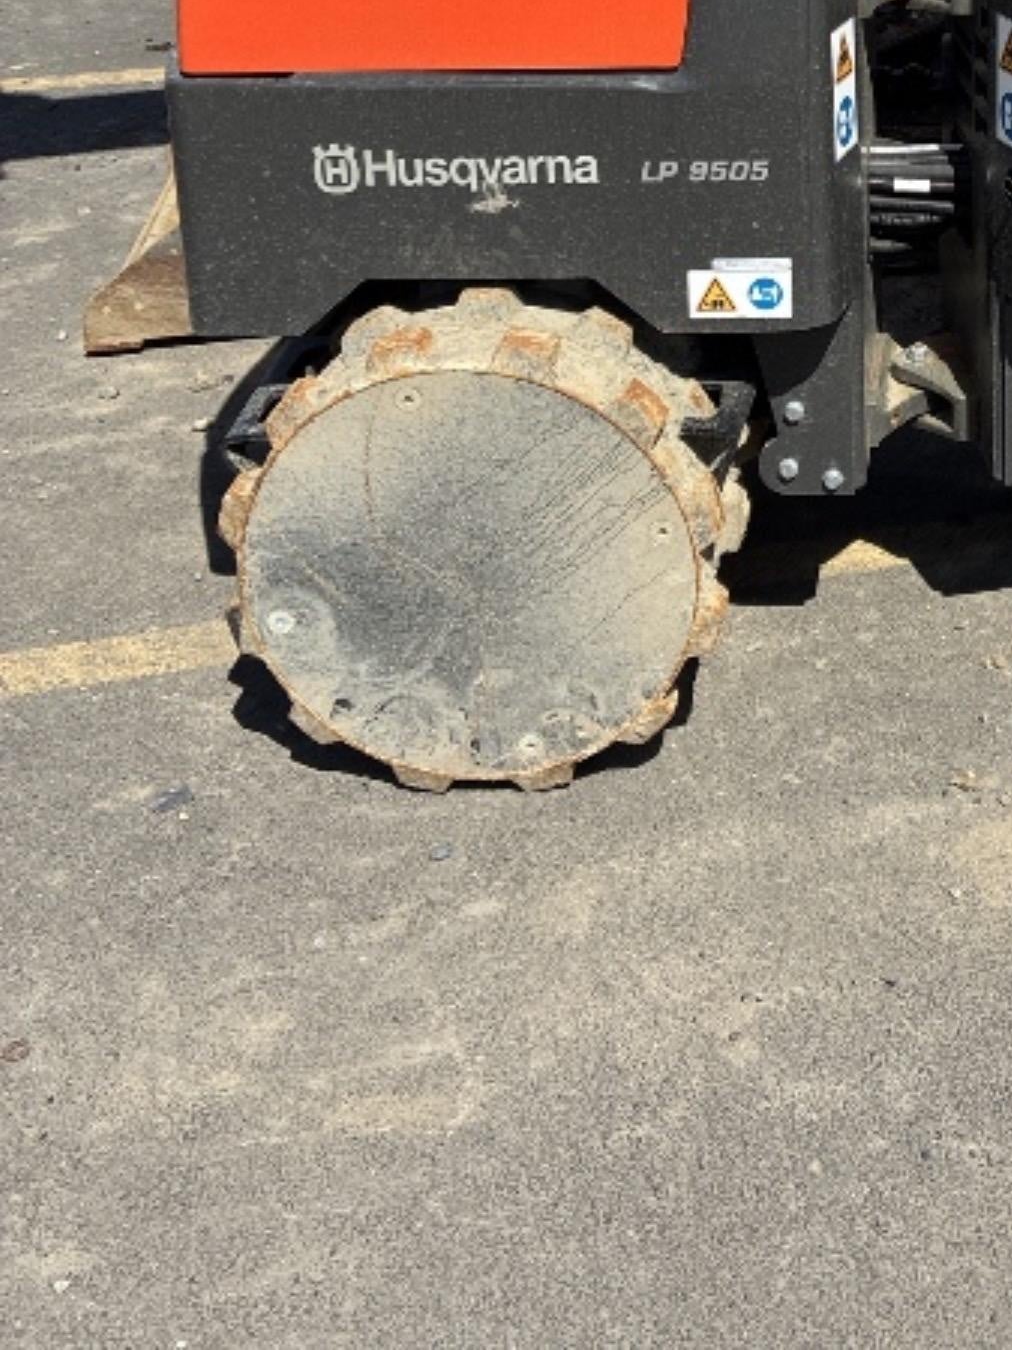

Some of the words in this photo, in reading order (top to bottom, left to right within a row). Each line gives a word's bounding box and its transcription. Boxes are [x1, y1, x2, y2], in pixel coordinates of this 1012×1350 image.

[364, 149, 600, 192] Husqvarna
[641, 160, 679, 182] LP
[688, 160, 770, 182] 9505
